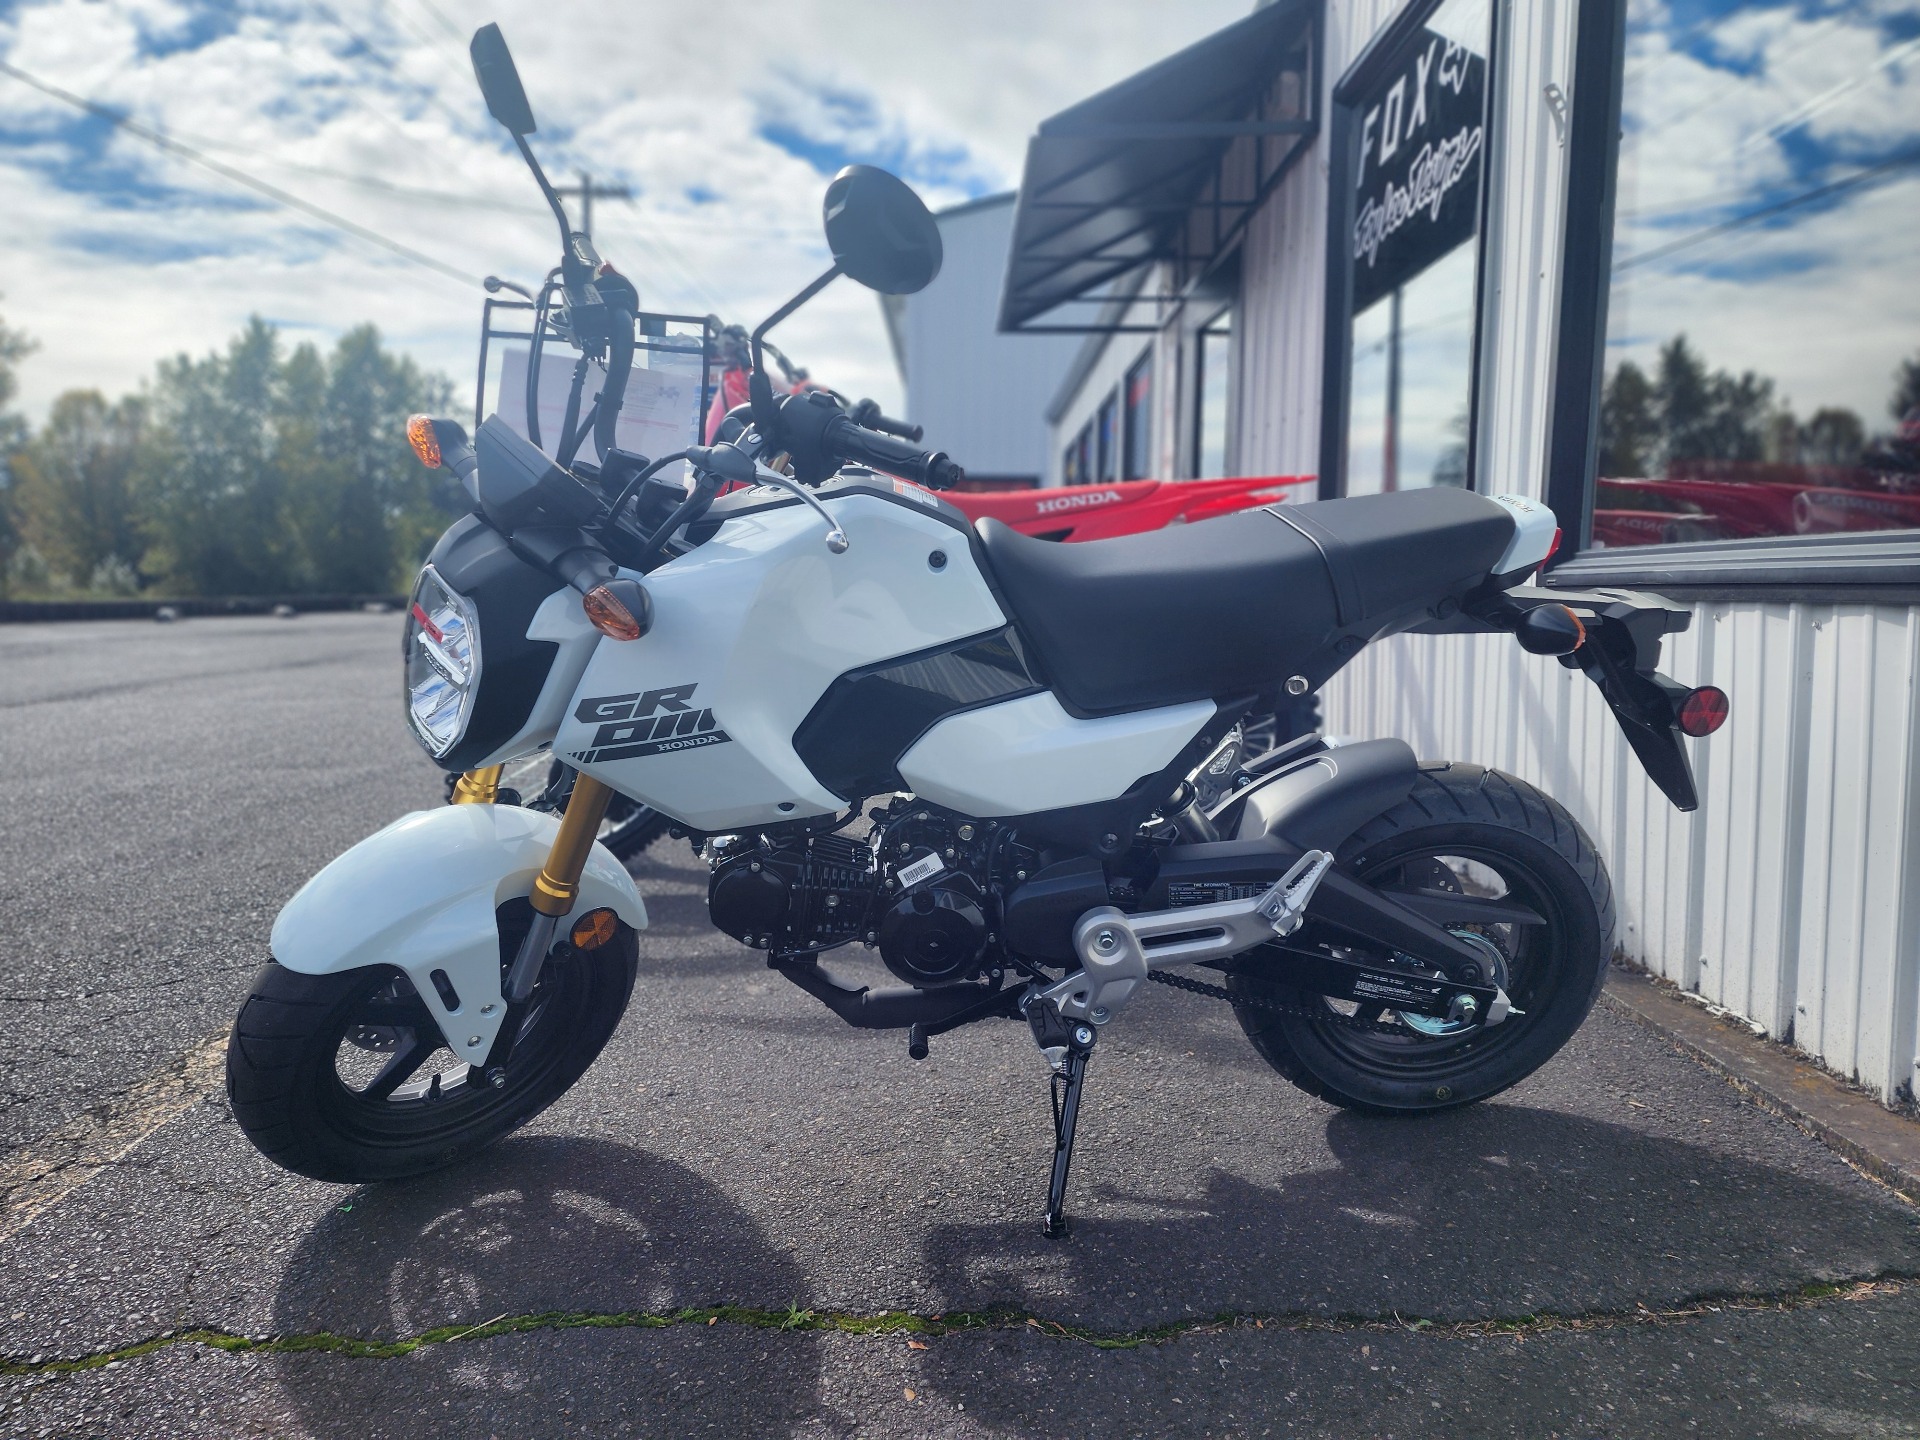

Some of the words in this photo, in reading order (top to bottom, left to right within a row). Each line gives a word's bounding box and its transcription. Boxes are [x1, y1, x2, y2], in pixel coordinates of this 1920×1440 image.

[1356, 37, 1437, 189] FOX
[1036, 489, 1122, 514] HONDA
[656, 734, 722, 752] HONDA
